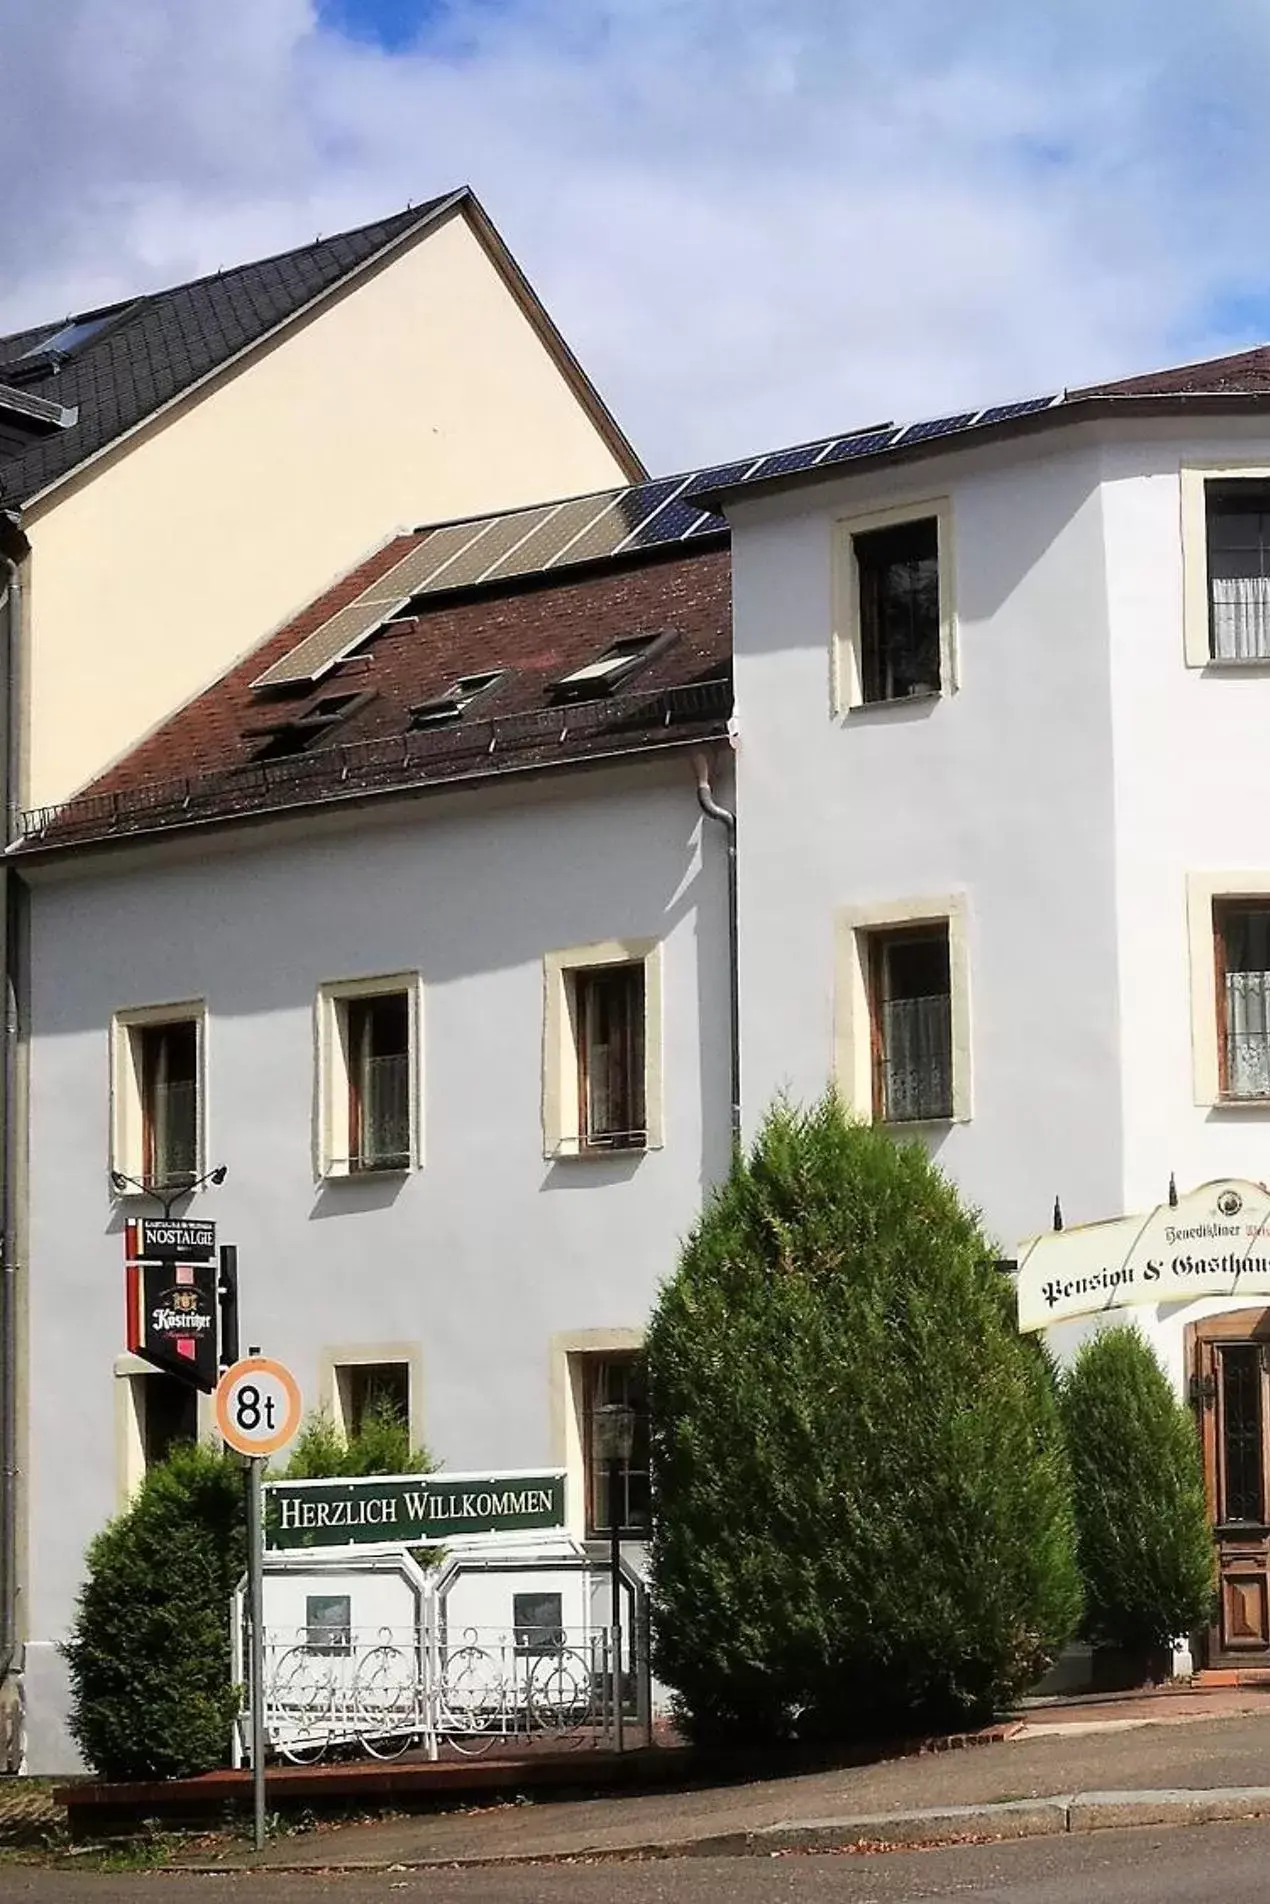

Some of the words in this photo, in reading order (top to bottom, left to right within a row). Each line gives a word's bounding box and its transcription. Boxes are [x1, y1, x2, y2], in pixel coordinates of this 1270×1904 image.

[145, 1229, 214, 1246] NOSTALGIE
[1042, 1267, 1135, 1308] Pension
[1143, 1259, 1164, 1281] &
[152, 1308, 212, 1331] Köstritzer
[280, 1498, 398, 1530] HERZLICH
[403, 1489, 554, 1521] WILLKOMMEN
